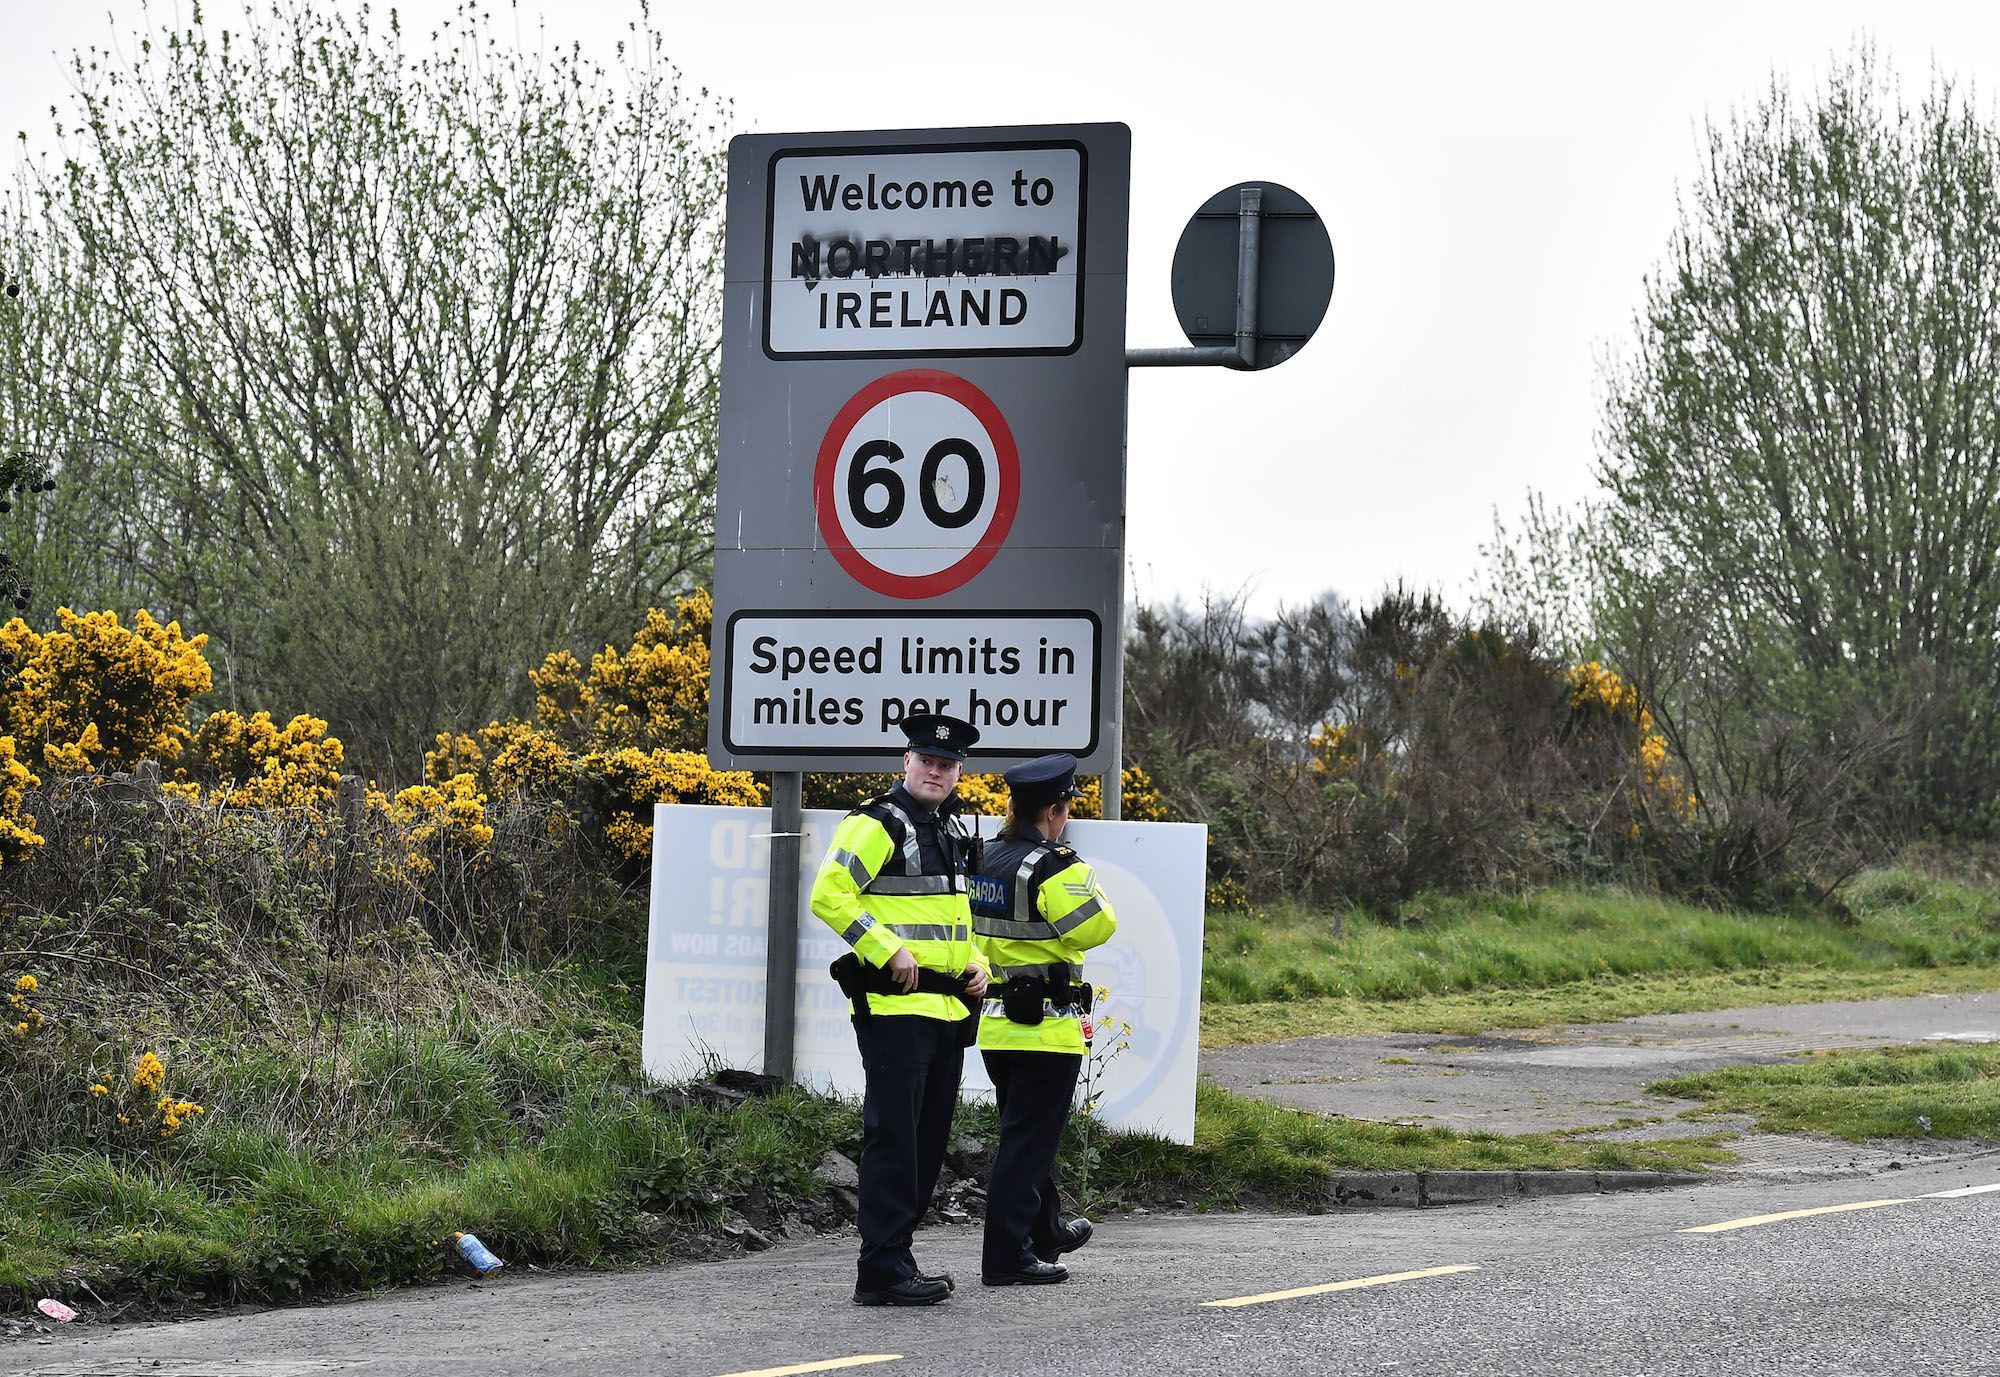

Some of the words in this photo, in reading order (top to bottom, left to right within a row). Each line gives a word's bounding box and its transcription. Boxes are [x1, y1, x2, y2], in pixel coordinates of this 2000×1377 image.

[800, 173, 994, 212] Welcome
[1012, 168, 1055, 207] to
[790, 236, 1060, 279] NORTHERN
[819, 288, 1028, 329] IRELAND
[846, 436, 987, 530] 60
[749, 636, 882, 681] Speed
[901, 636, 1020, 675] limits
[1038, 637, 1076, 675] in
[753, 688, 864, 726] miles
[881, 697, 951, 732] per
[969, 689, 1067, 727] hour
[970, 880, 1006, 905] GARDA
